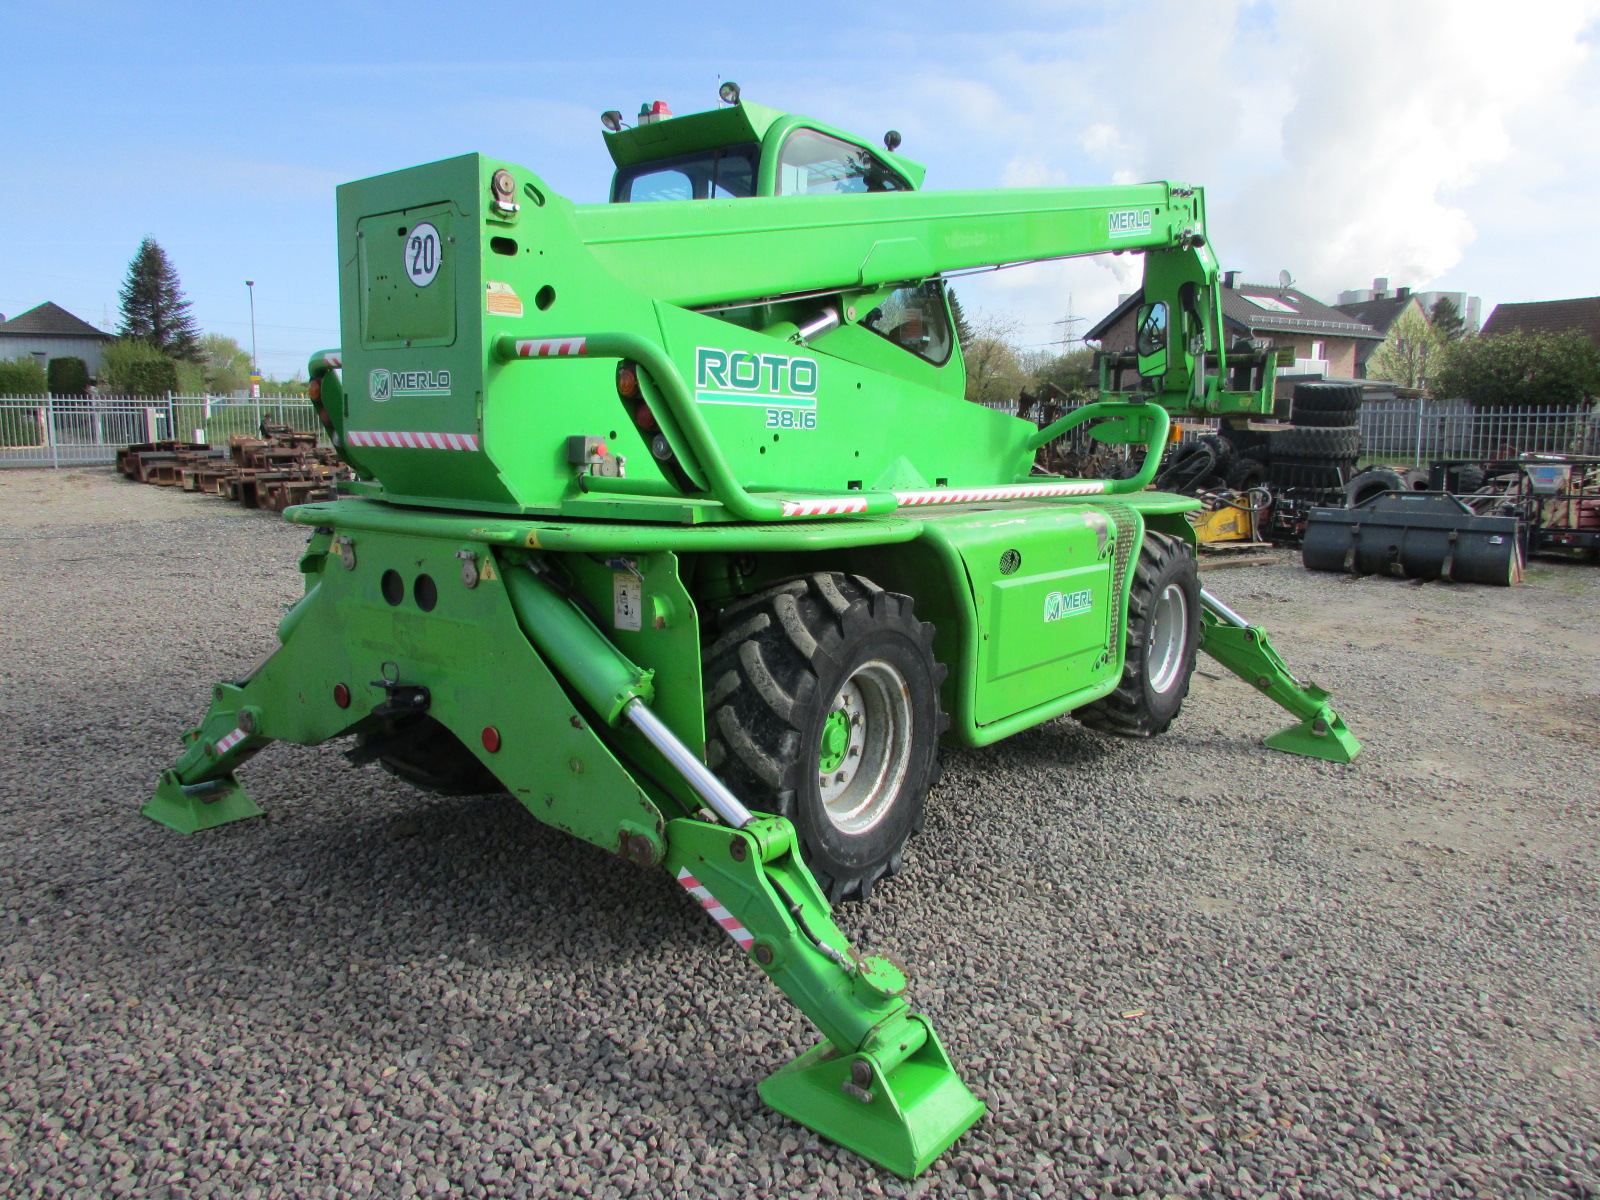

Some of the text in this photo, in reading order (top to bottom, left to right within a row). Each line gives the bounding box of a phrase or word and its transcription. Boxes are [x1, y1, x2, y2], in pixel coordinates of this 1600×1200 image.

[1109, 209, 1151, 231] MERLO
[411, 234, 435, 276] 20
[392, 370, 451, 389] MERLO
[696, 346, 818, 395] ROTO
[766, 409, 816, 429] 38.16
